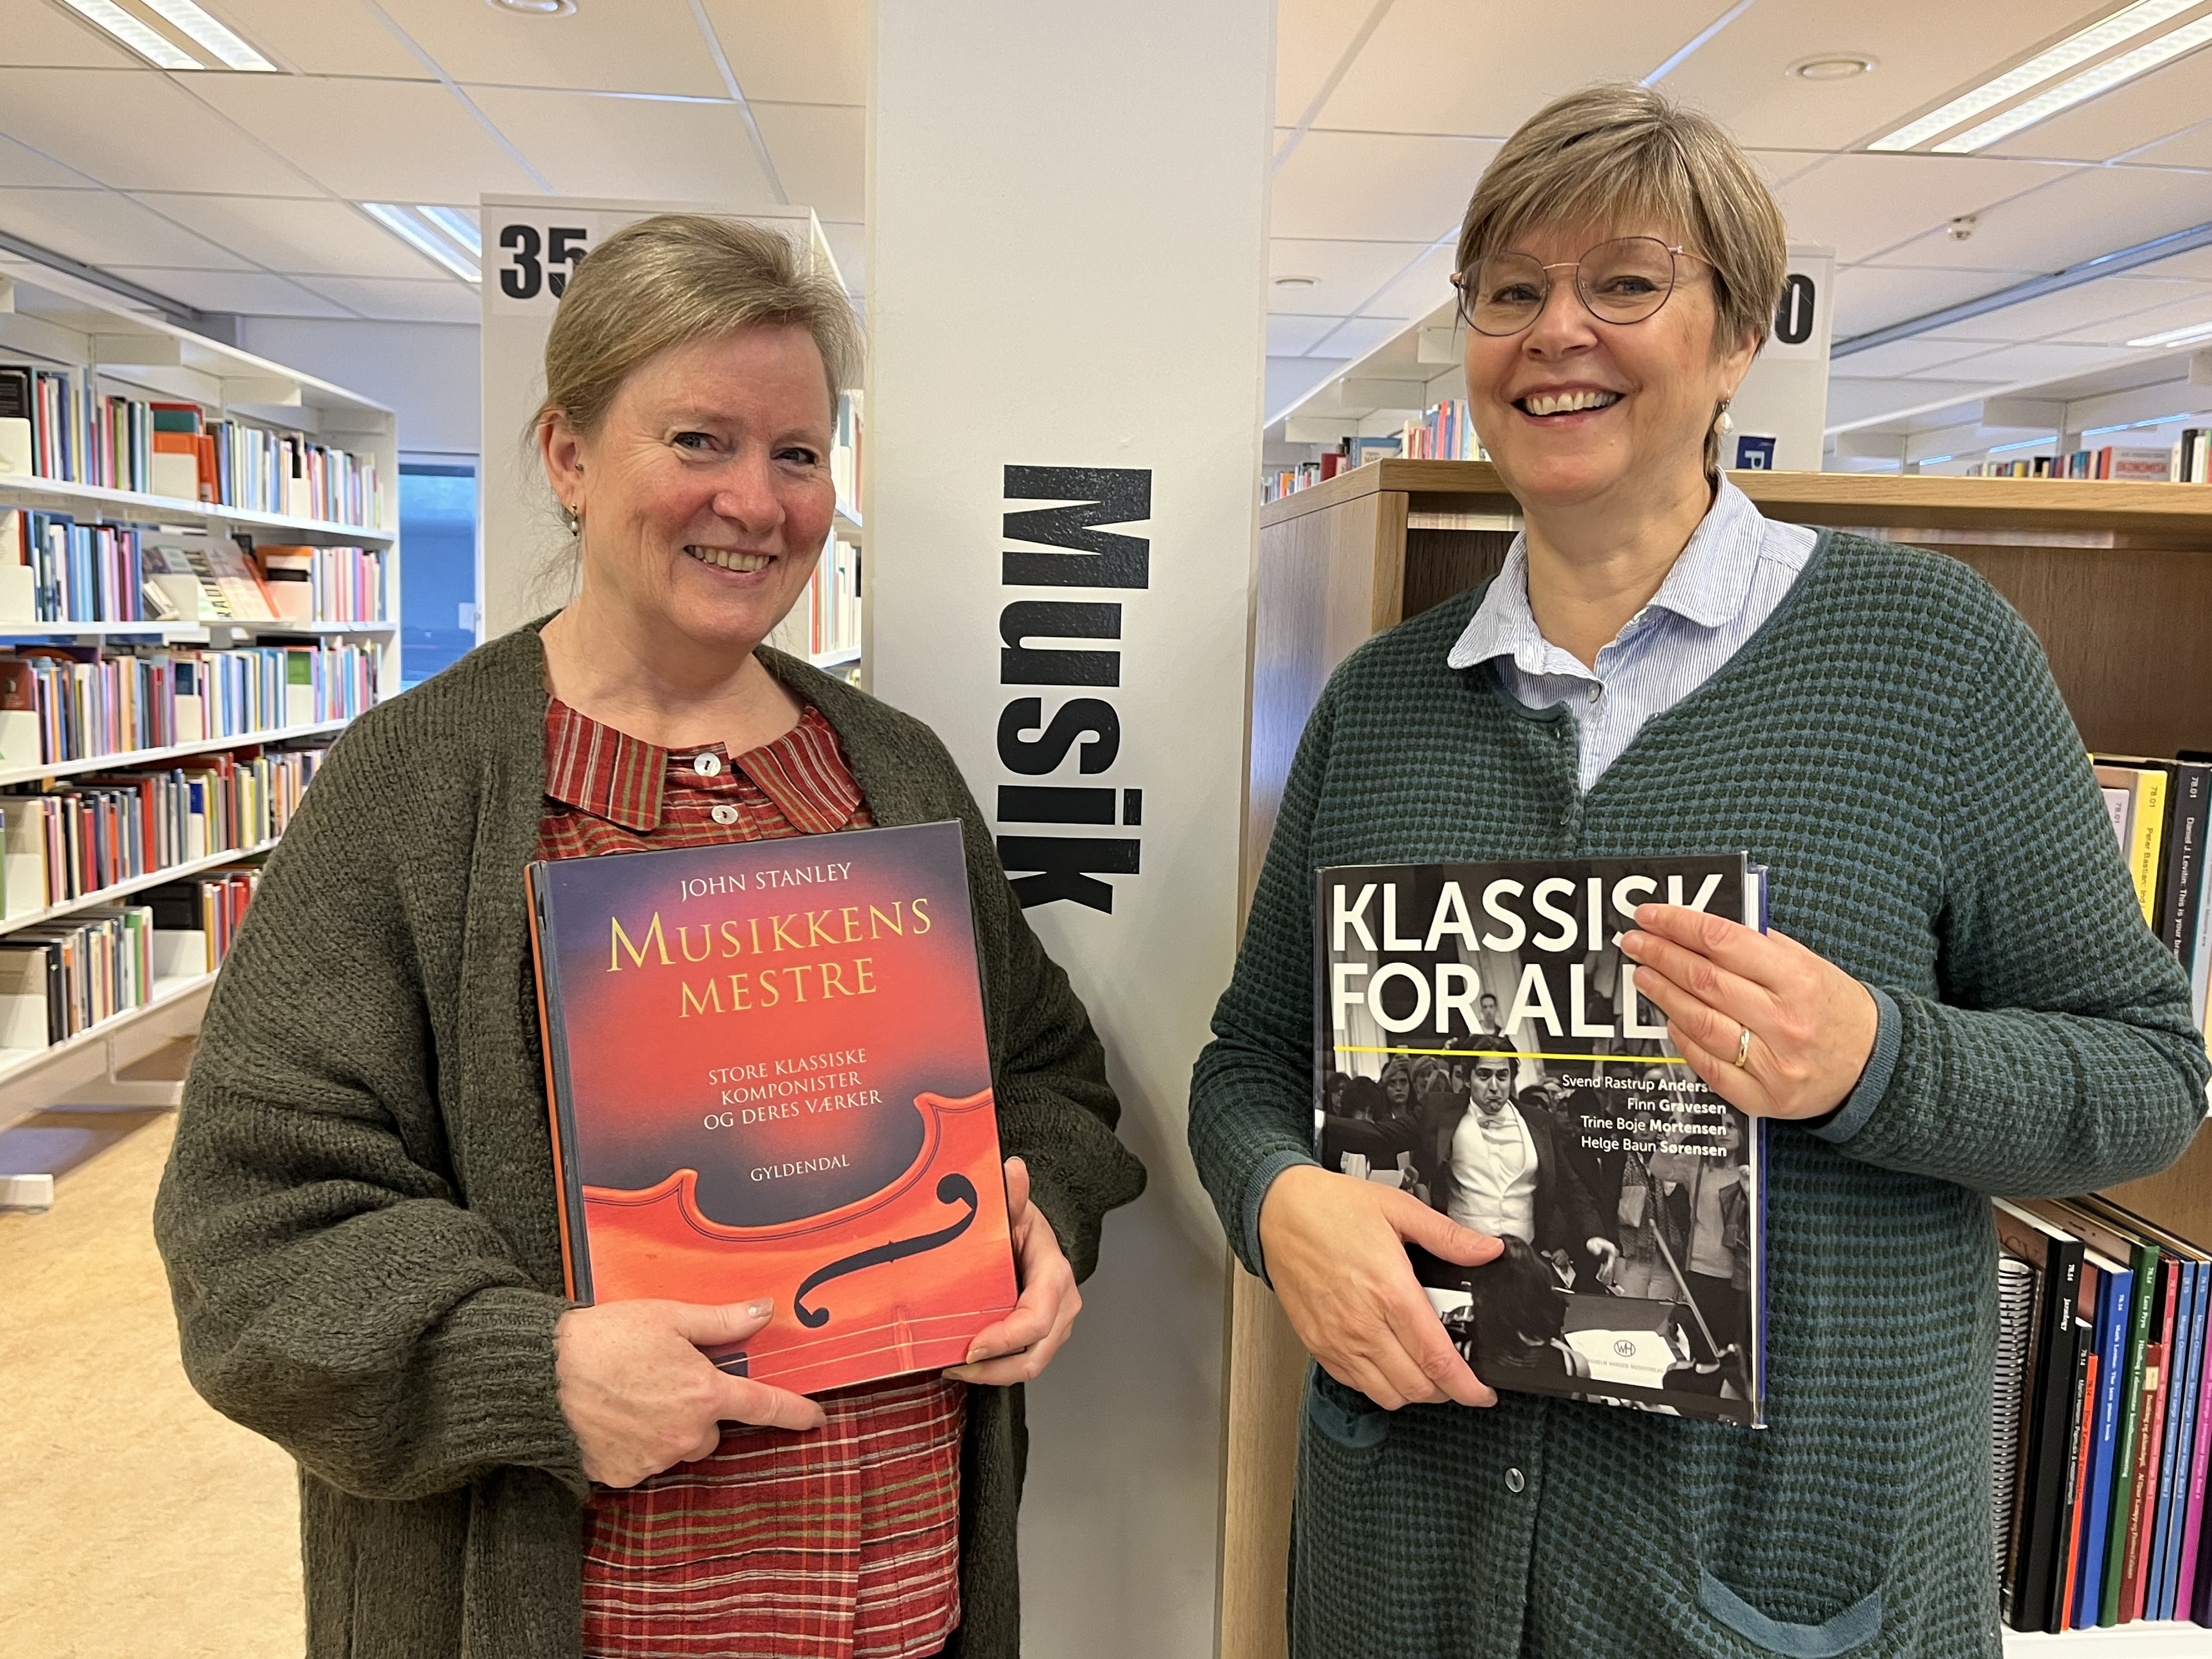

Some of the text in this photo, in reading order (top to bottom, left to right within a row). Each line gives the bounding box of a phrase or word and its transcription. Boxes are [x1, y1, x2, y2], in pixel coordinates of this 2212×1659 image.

[500, 225, 588, 299] 35
[996, 465, 1152, 915] Musik
[2149, 786, 2158, 808] 78.01
[2190, 776, 2199, 798] 78.01
[2114, 803, 2122, 823] 78.01
[2145, 827, 2153, 850] Peter
[2185, 817, 2194, 844] Daniel
[681, 862, 851, 902] JOHN STANLEY
[2141, 852, 2151, 887] Bastian:
[2180, 855, 2191, 887] Levitin:
[2138, 890, 2147, 903] Ind
[2178, 889, 2188, 907] This
[2177, 909, 2185, 917] is
[606, 898, 932, 972] MUSIKKENS
[2175, 918, 2183, 938] your
[679, 958, 877, 1018] MESTRE
[1333, 961, 1485, 1035] FOR
[708, 1048, 867, 1086] STORE KLASSISKE
[721, 1071, 862, 1105] KOMPONISTER
[1562, 1074, 1601, 1088] Svend
[1604, 1075, 1655, 1092] Rastrup
[703, 1090, 883, 1130] OG DERES VÆRKER
[1627, 1097, 1726, 1114] Finn Gravesen
[1580, 1115, 1727, 1136] Trine Boje Mortensen
[1581, 1135, 1727, 1157] Helge Baun Sørensen
[750, 1154, 850, 1182] GYLDENDAL
